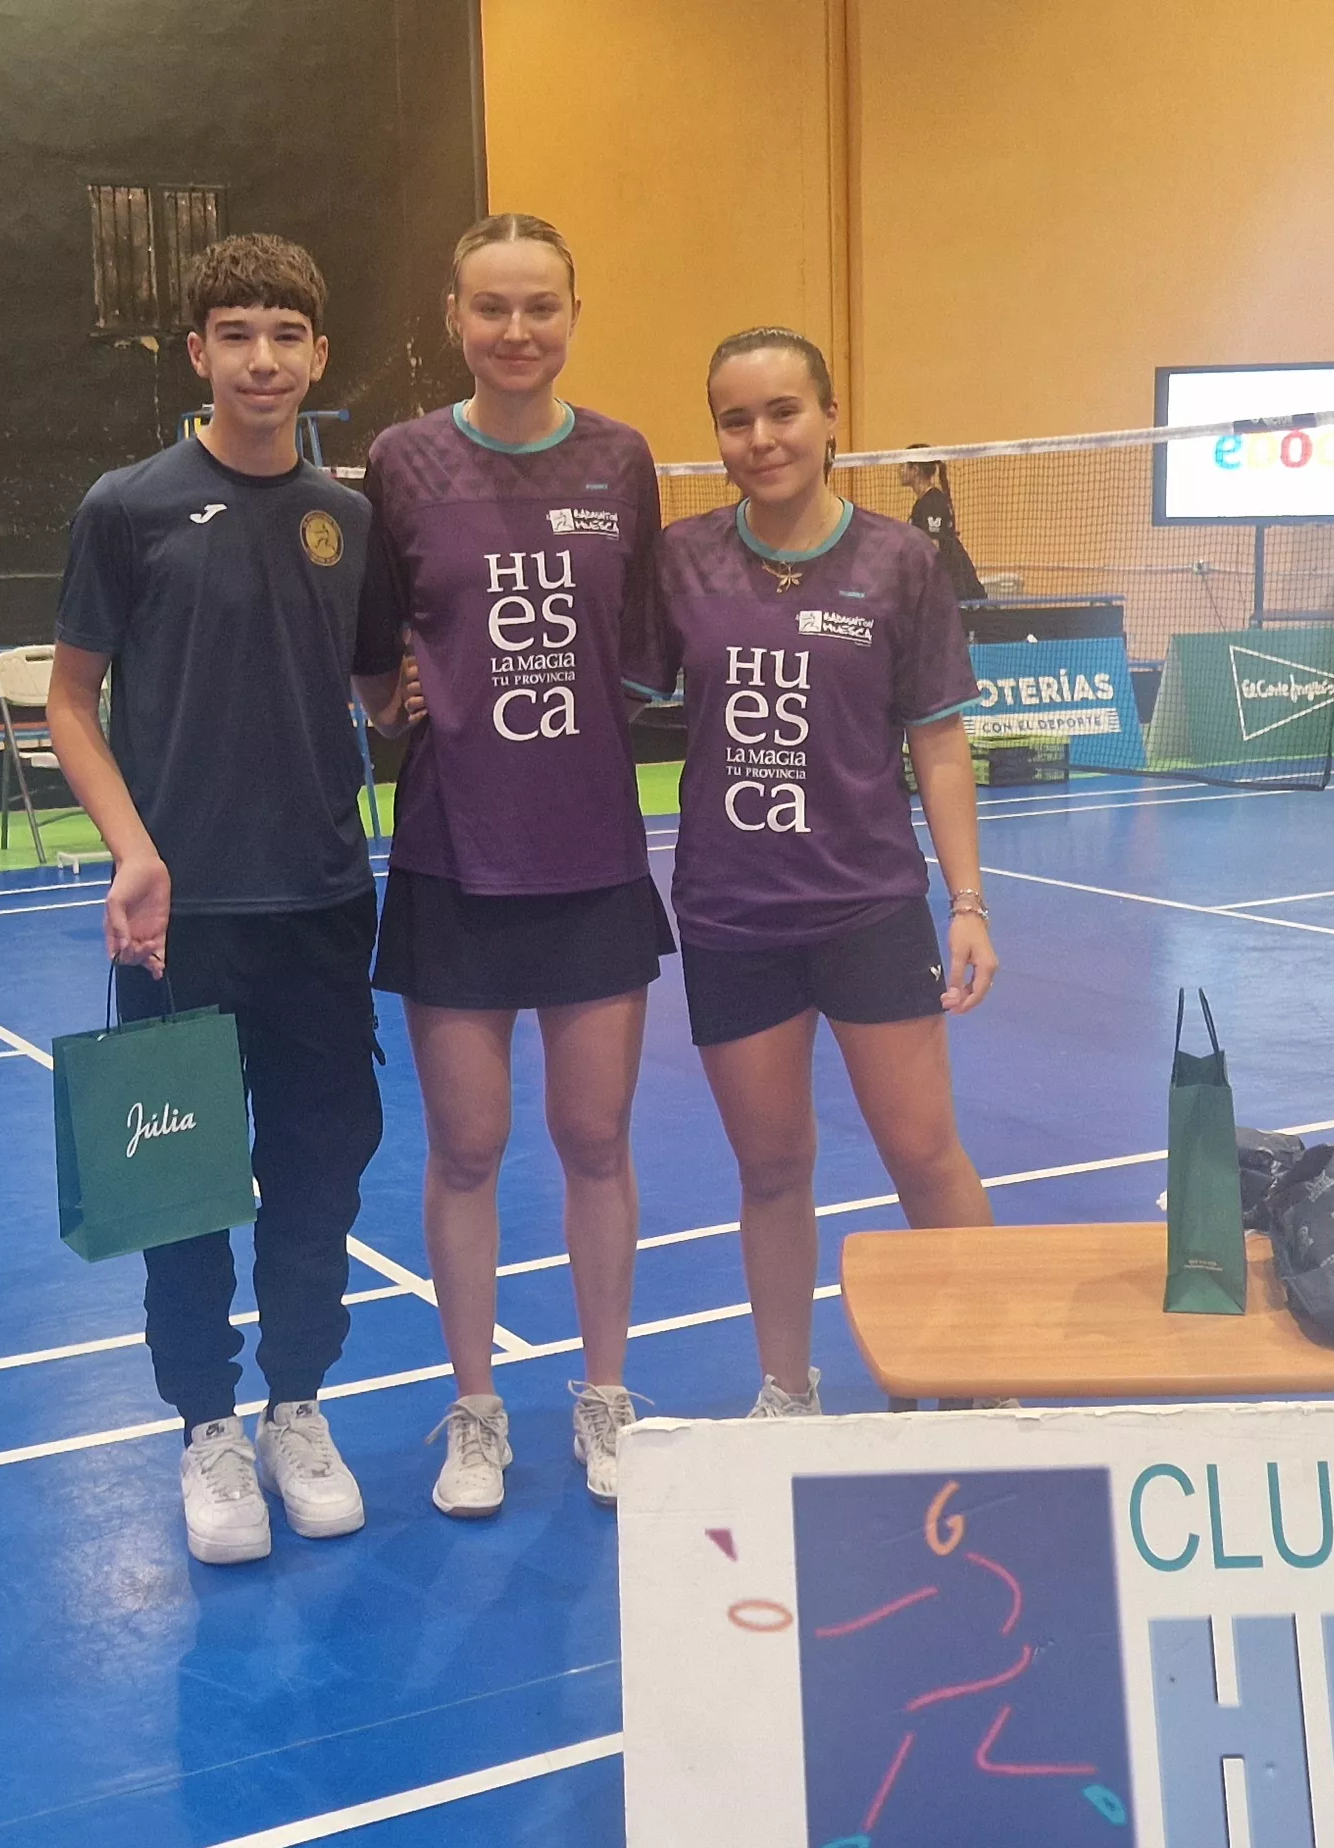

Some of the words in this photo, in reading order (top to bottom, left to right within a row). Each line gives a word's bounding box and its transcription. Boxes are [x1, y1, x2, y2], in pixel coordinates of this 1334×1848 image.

[488, 593, 577, 651] es
[493, 686, 580, 741] ca
[976, 669, 1114, 708] OTERÍAS
[725, 690, 809, 746] es
[982, 721, 1012, 733] CON
[1018, 718, 1033, 731] EL
[1037, 716, 1102, 730] DEPORTE
[725, 780, 811, 833] ca
